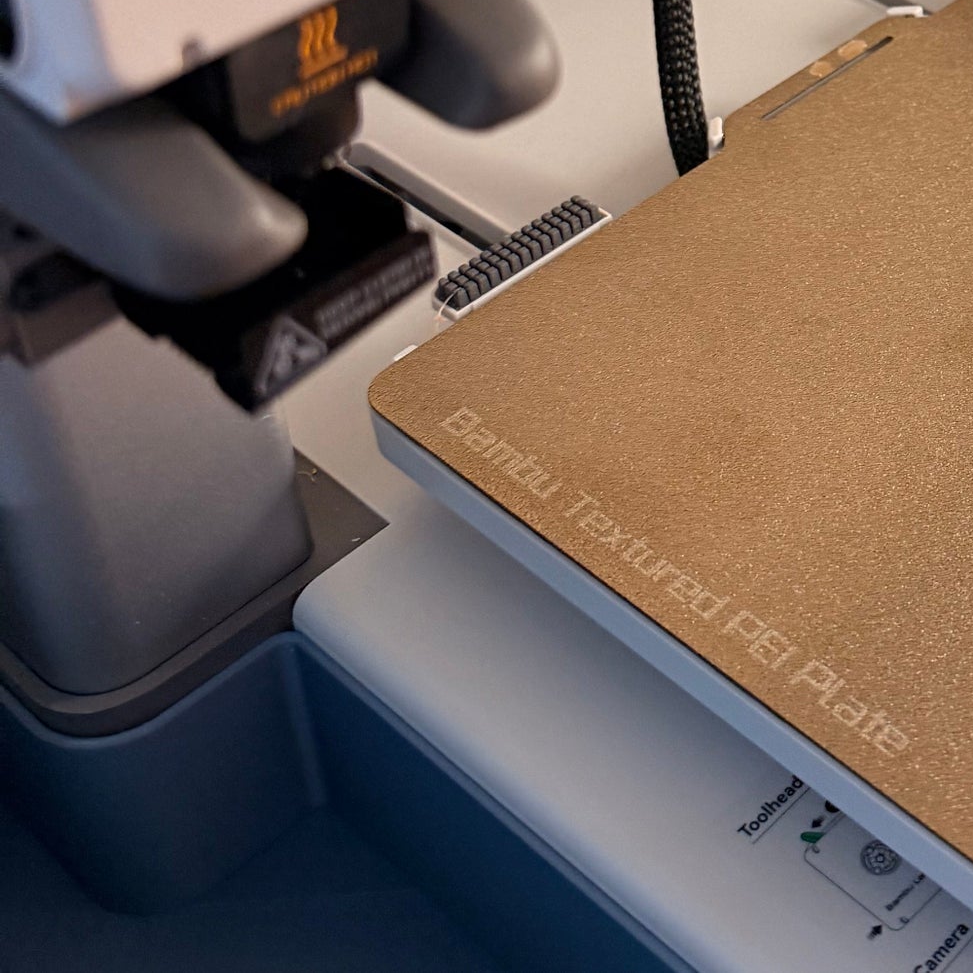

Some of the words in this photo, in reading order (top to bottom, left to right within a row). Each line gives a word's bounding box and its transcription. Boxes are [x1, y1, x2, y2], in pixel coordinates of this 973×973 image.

[439, 406, 562, 500] Bambu
[564, 488, 731, 621] Textured
[724, 609, 799, 671] PEI
[790, 659, 910, 757] Plate
[737, 774, 804, 838] Toolhead
[913, 923, 970, 973] Camera
